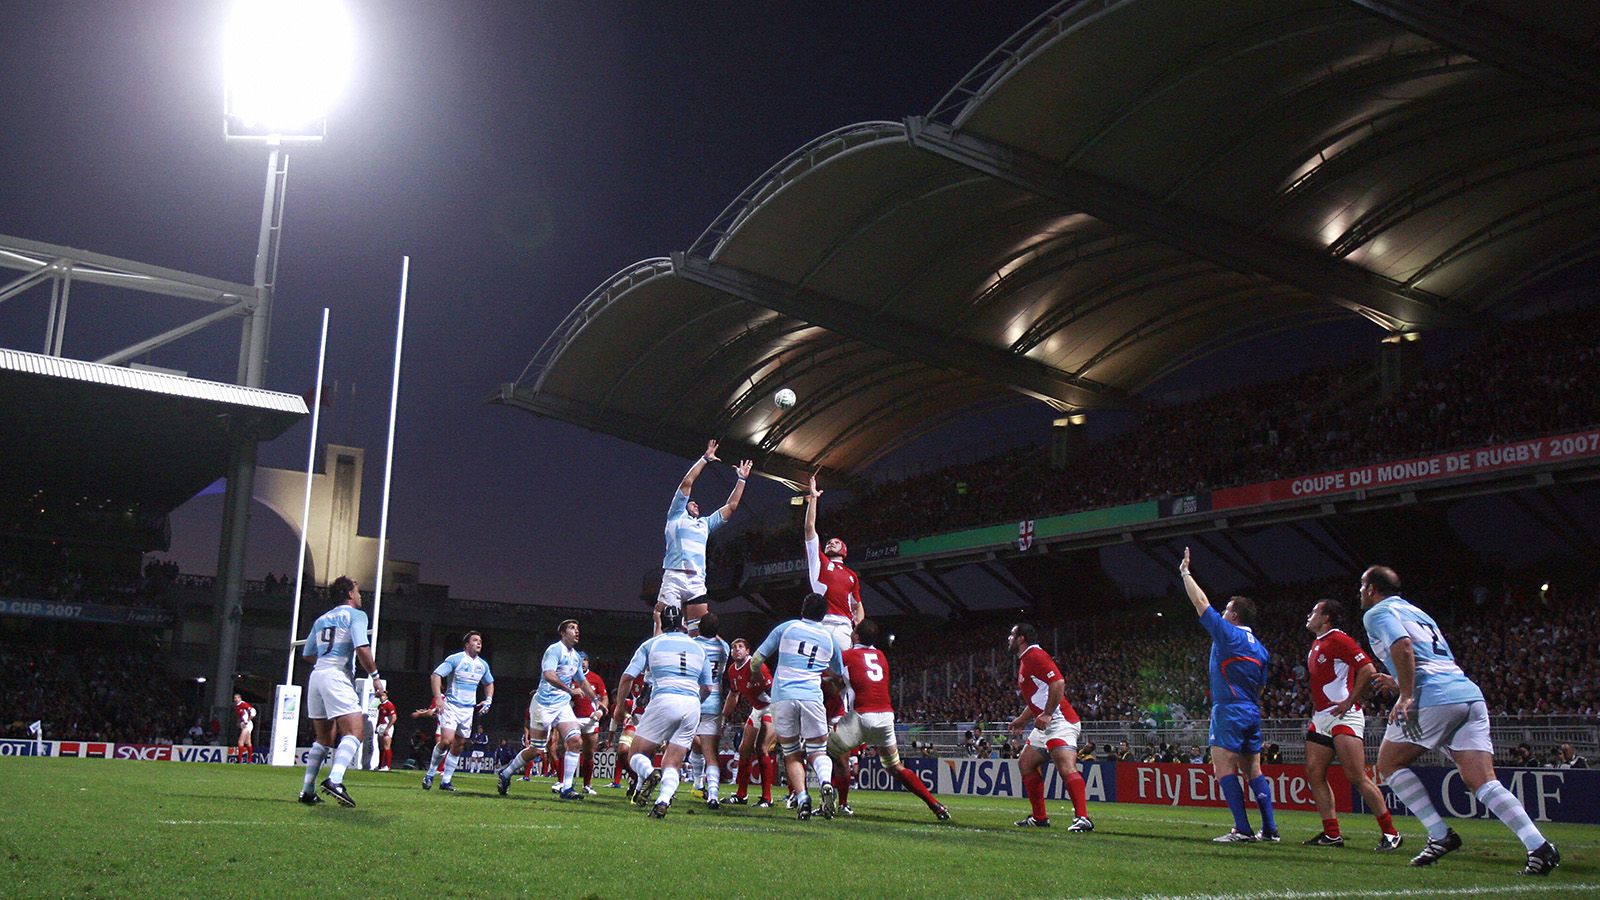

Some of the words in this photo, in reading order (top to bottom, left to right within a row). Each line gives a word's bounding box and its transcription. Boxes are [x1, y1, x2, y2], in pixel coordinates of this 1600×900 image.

[1291, 473, 1346, 495] COUPE
[1349, 469, 1373, 487] DU
[1378, 459, 1440, 482] MONDE
[1446, 454, 1471, 473] DE
[1475, 442, 1542, 468] RUGBY
[1550, 434, 1600, 457] 2007
[761, 561, 793, 576] WORLD
[796, 560, 808, 571] CU
[11, 602, 42, 614] CUP
[46, 604, 82, 617] 2007
[320, 626, 336, 656] 9
[1416, 621, 1448, 656] 2
[676, 650, 687, 675] 1
[798, 641, 819, 669] 4
[864, 653, 883, 682] 5
[118, 746, 170, 760] SNCF
[176, 747, 223, 763] VISA
[465, 757, 494, 771] HGER
[944, 760, 1013, 796] VISA
[1037, 762, 1107, 802] VIA
[1137, 767, 1182, 806] Fly
[1187, 768, 1318, 807] Emite
